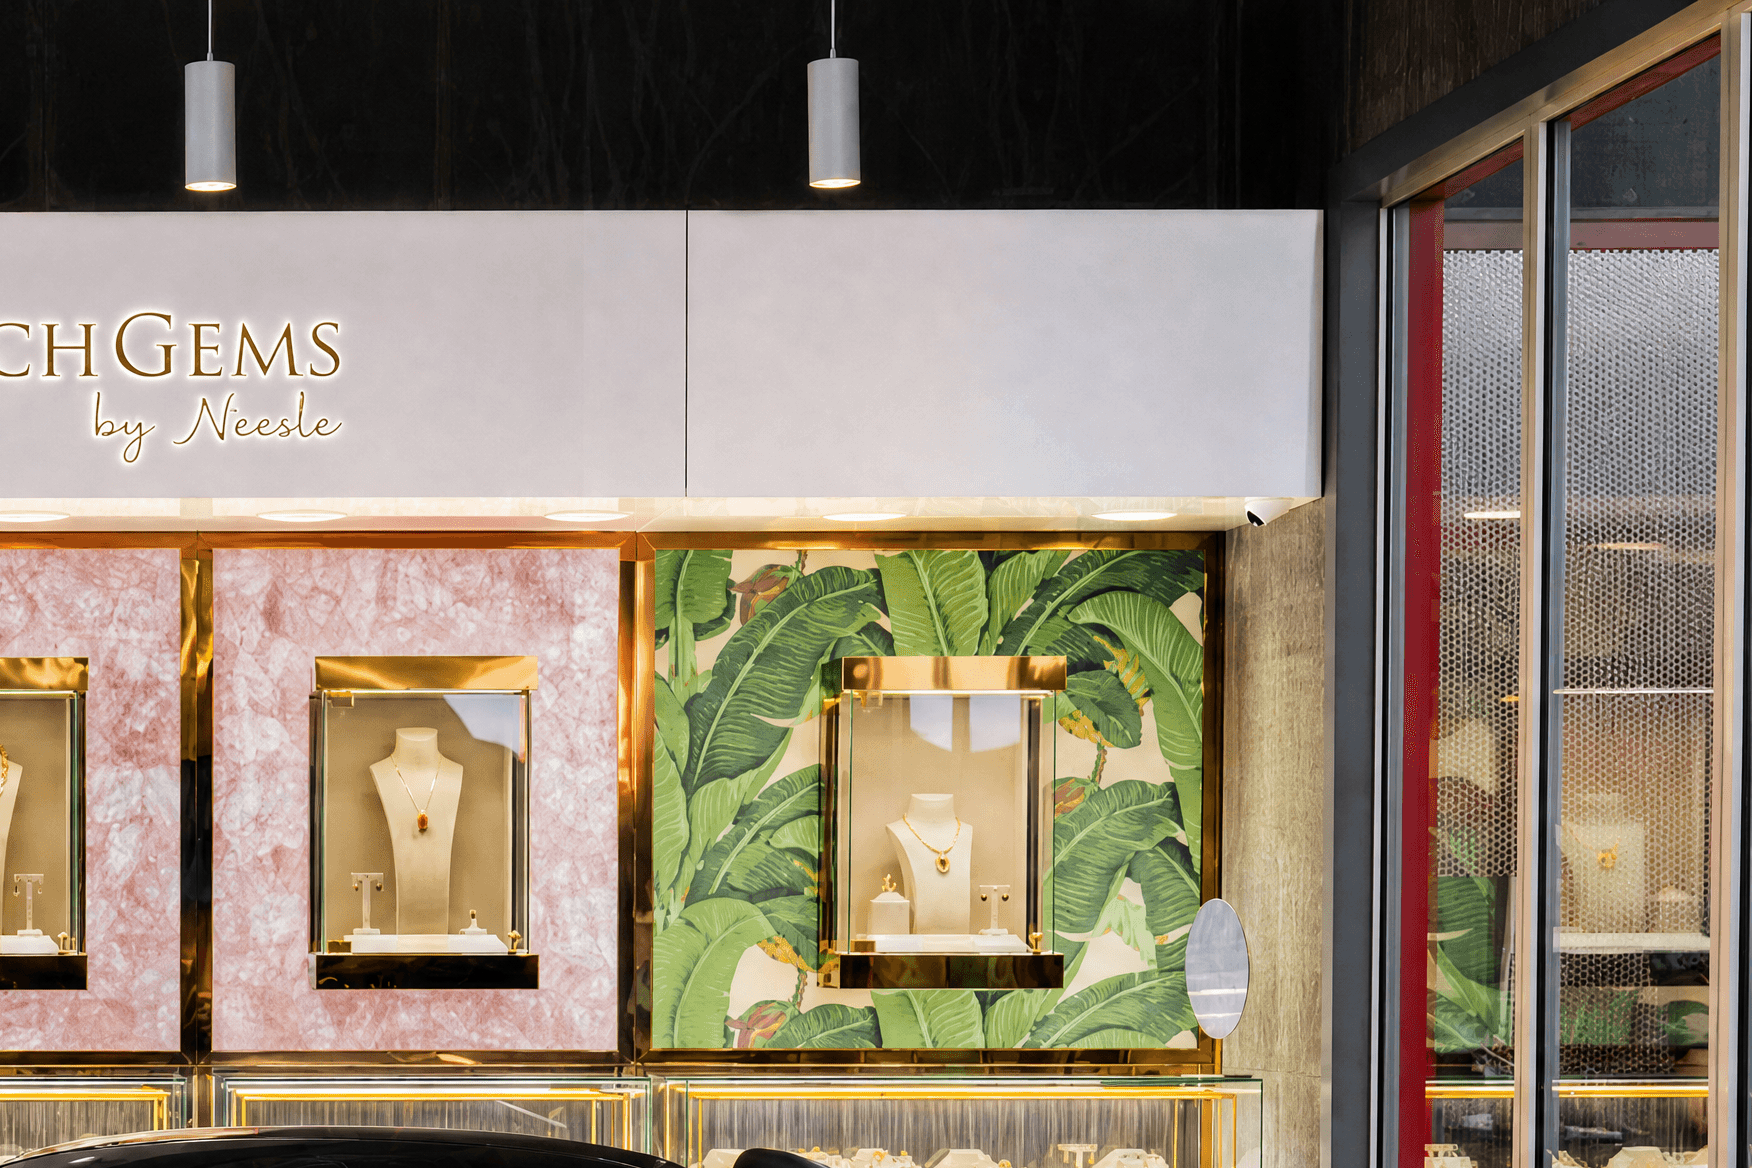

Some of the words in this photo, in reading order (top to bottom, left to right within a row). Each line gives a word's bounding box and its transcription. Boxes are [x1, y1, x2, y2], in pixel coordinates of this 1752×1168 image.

[115, 311, 341, 378] GEMS
[94, 391, 156, 464] by
[172, 391, 342, 445] Neesle
